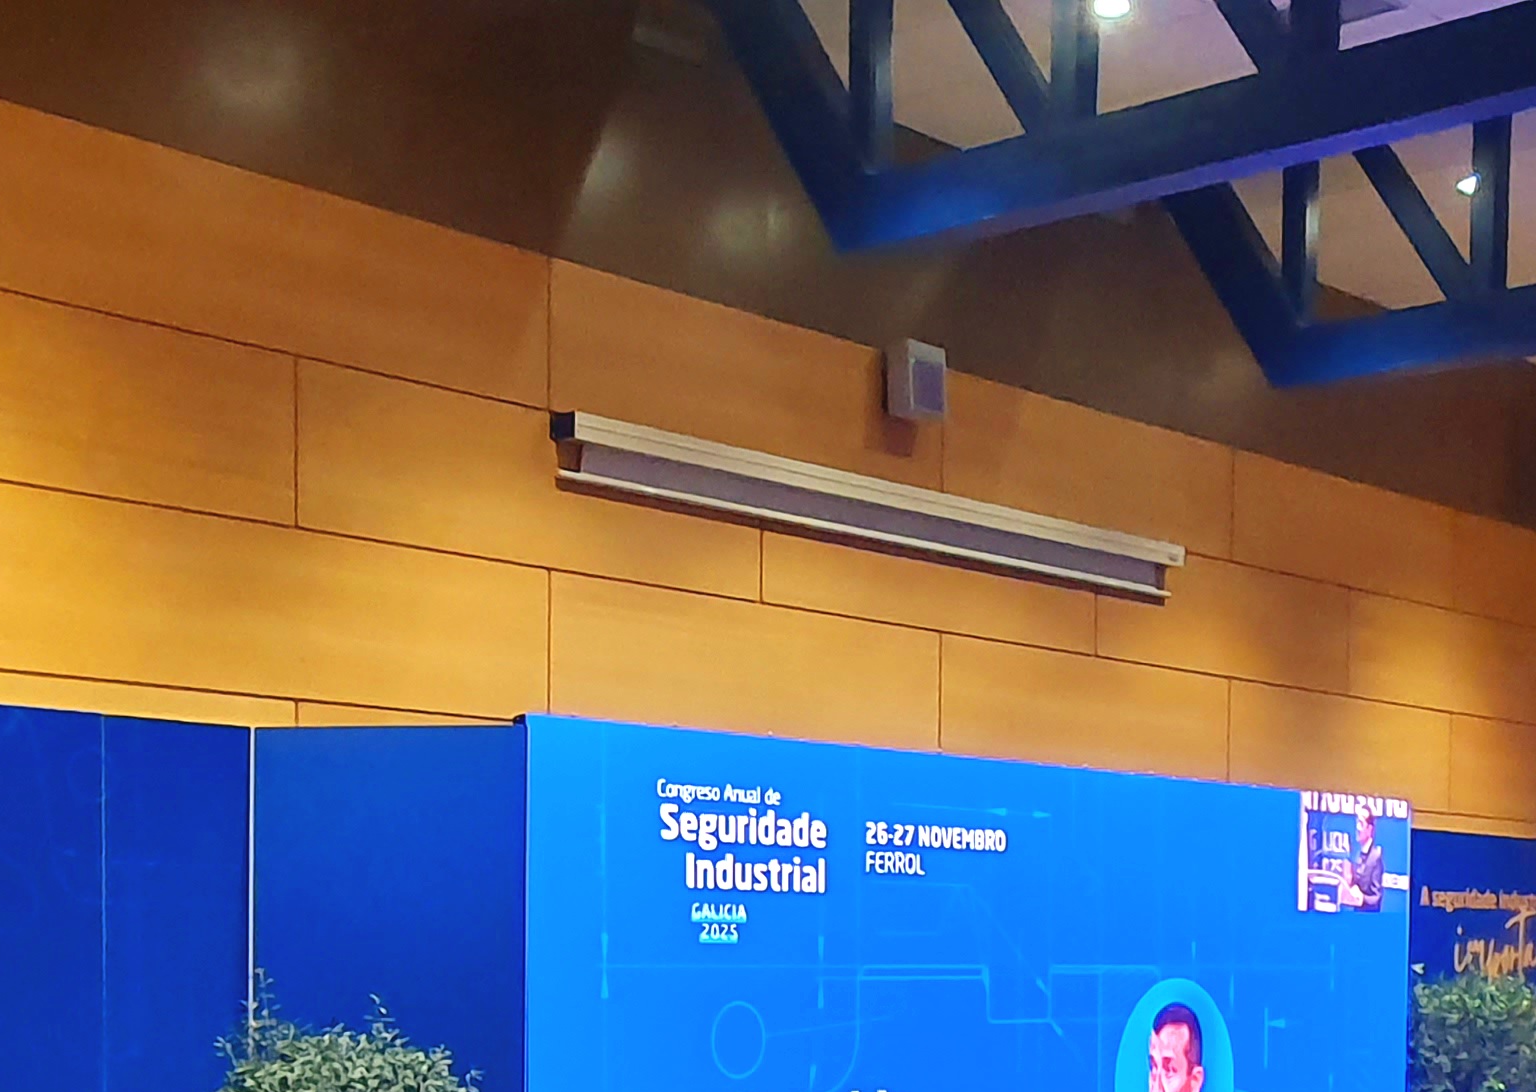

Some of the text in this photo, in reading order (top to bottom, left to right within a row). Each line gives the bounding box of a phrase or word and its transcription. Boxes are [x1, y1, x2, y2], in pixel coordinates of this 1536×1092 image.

[657, 778, 781, 805] Congreso Anual de
[659, 803, 827, 851] Seguridade
[865, 821, 1007, 852] 26-27 NOVEMBRO
[685, 852, 826, 893] Industrial
[865, 851, 926, 876] FERROL
[701, 923, 739, 941] 2025
